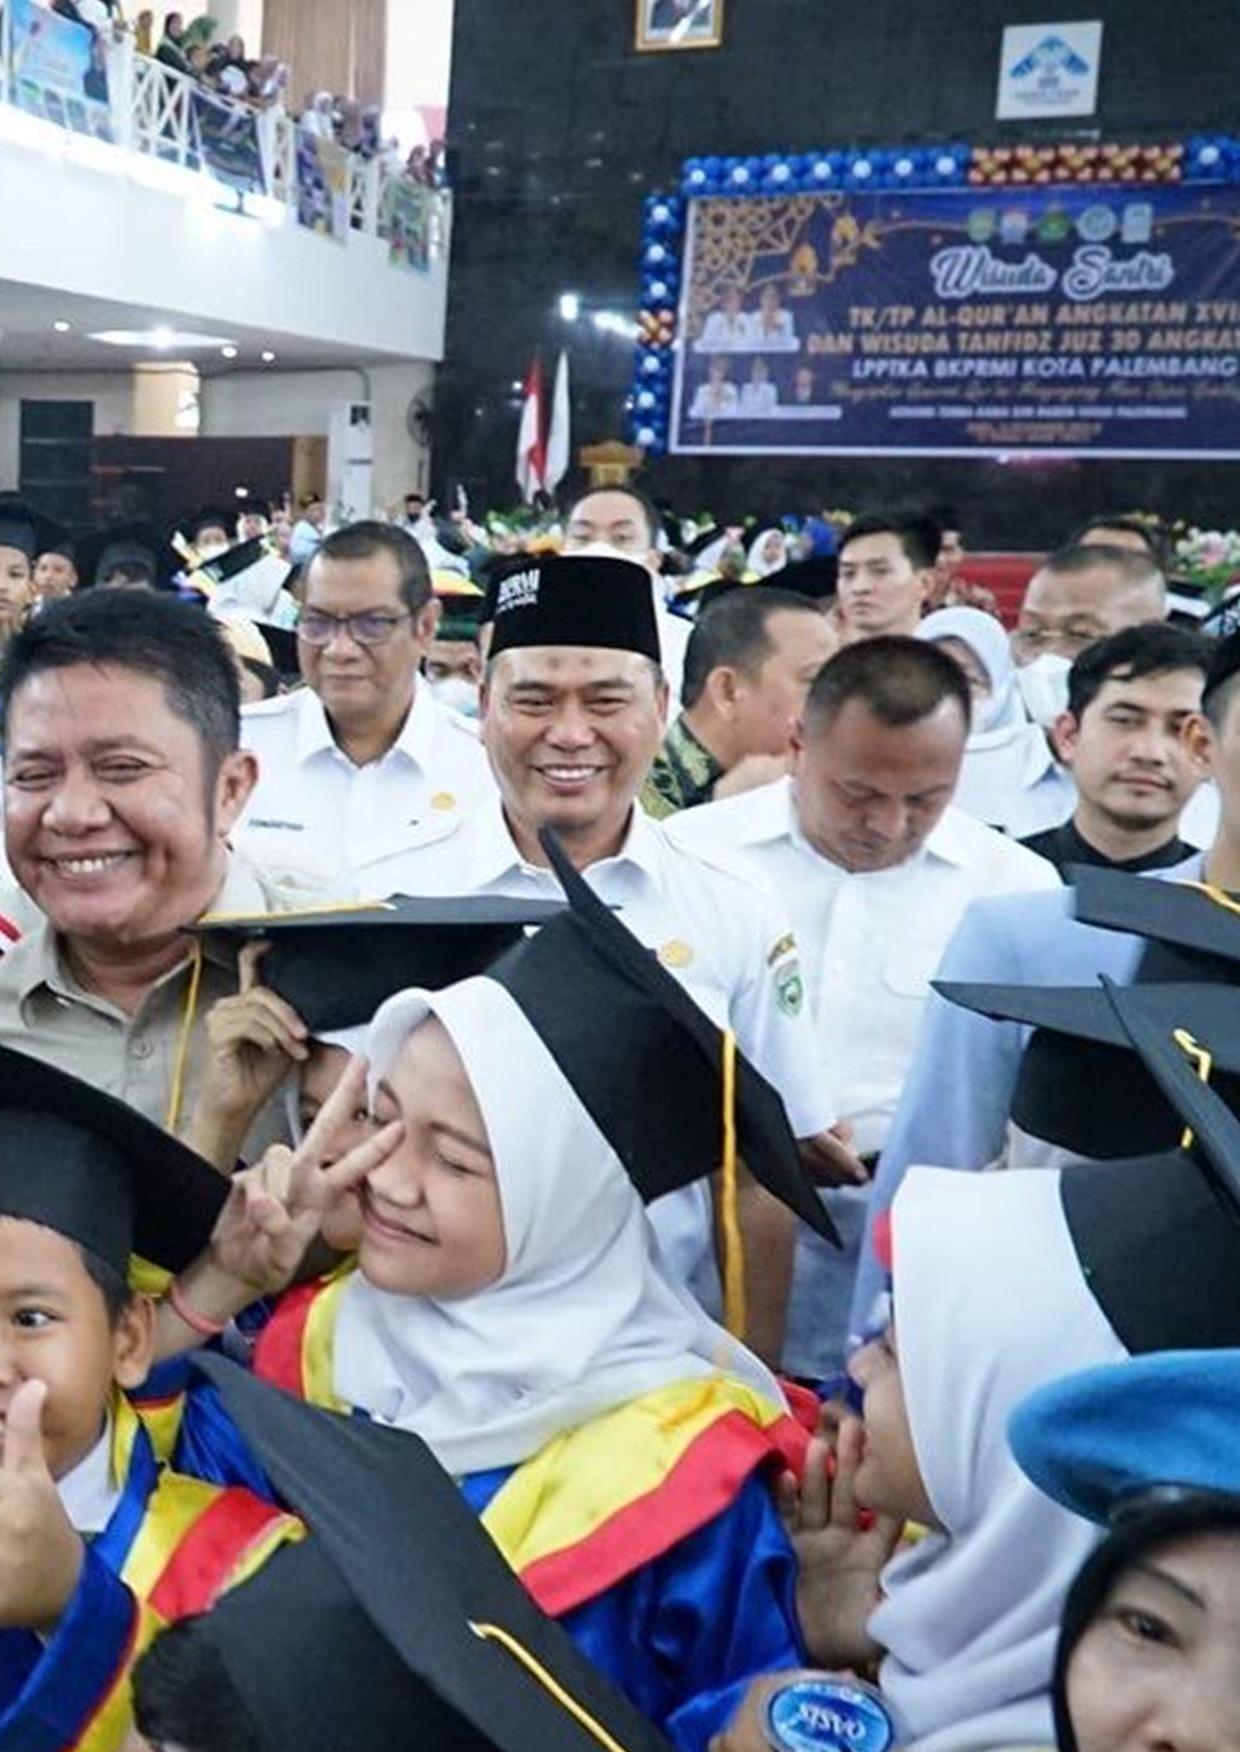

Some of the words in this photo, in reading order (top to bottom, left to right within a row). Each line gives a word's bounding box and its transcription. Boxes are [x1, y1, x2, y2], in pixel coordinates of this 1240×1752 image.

[930, 246, 1057, 297] Wisuda
[1062, 245, 1175, 300] Santri
[848, 306, 915, 330] TK/TP
[1056, 303, 1187, 324] ANGKATAN
[807, 333, 854, 353] DAN
[861, 332, 950, 353] WISUDA
[1060, 331, 1102, 351] JUZ
[1111, 331, 1142, 349] 30
[934, 359, 1018, 377] BKPRMI
[1022, 358, 1084, 377] KOTA
[1090, 356, 1239, 376] PALEMBANG
